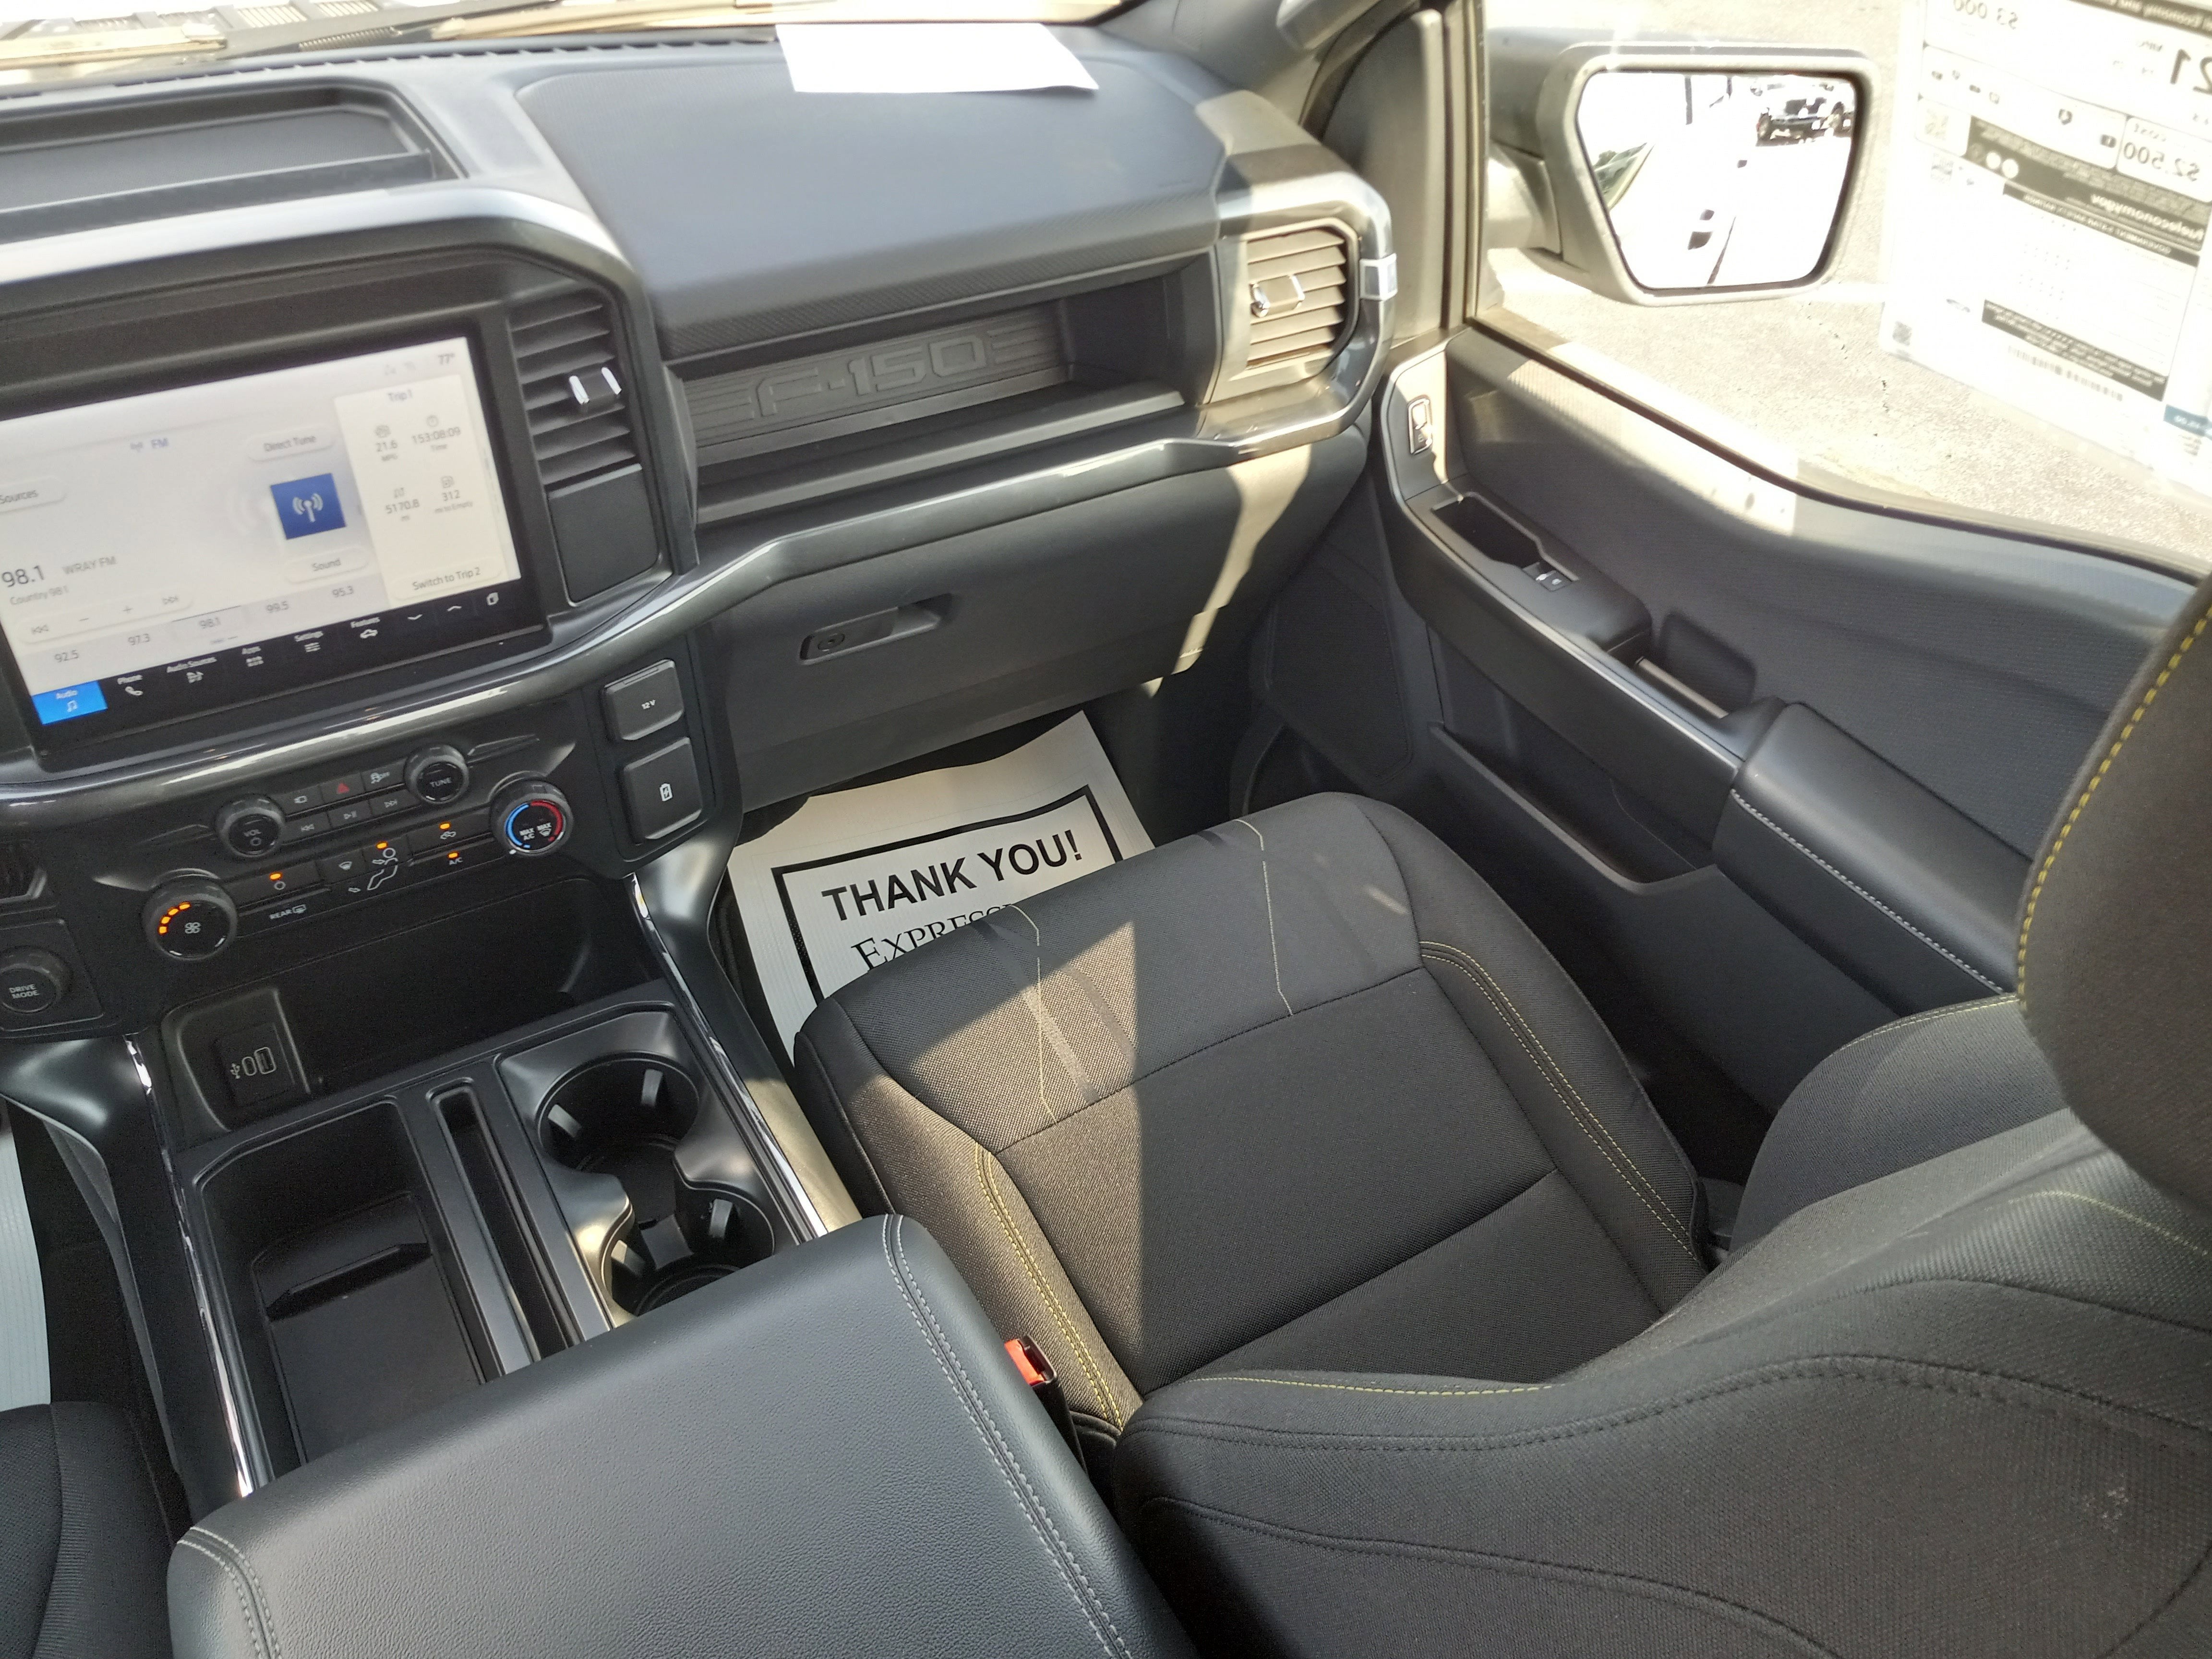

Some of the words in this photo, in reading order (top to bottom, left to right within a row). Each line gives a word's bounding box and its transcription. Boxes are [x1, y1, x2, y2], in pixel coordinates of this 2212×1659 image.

[756, 335, 987, 418] F-150
[442, 490, 460, 502] 312
[1, 565, 45, 588] 98.1
[412, 578, 444, 590] Switch
[445, 575, 455, 583] to
[456, 570, 474, 580] Trip
[474, 566, 481, 576] 2
[331, 585, 354, 598] 95.3
[127, 633, 151, 646] 97.3
[54, 649, 80, 663] 92.5
[430, 777, 452, 788] TUNE
[519, 828, 535, 837] MAX
[537, 822, 553, 831] MAX
[449, 857, 463, 866] A/C
[821, 857, 977, 921] THANK
[977, 830, 1082, 882] YOU!
[269, 909, 292, 920] REAR
[851, 903, 1012, 973] EXPRE
[9, 984, 37, 994] DRIVE
[12, 990, 40, 999] MODE
